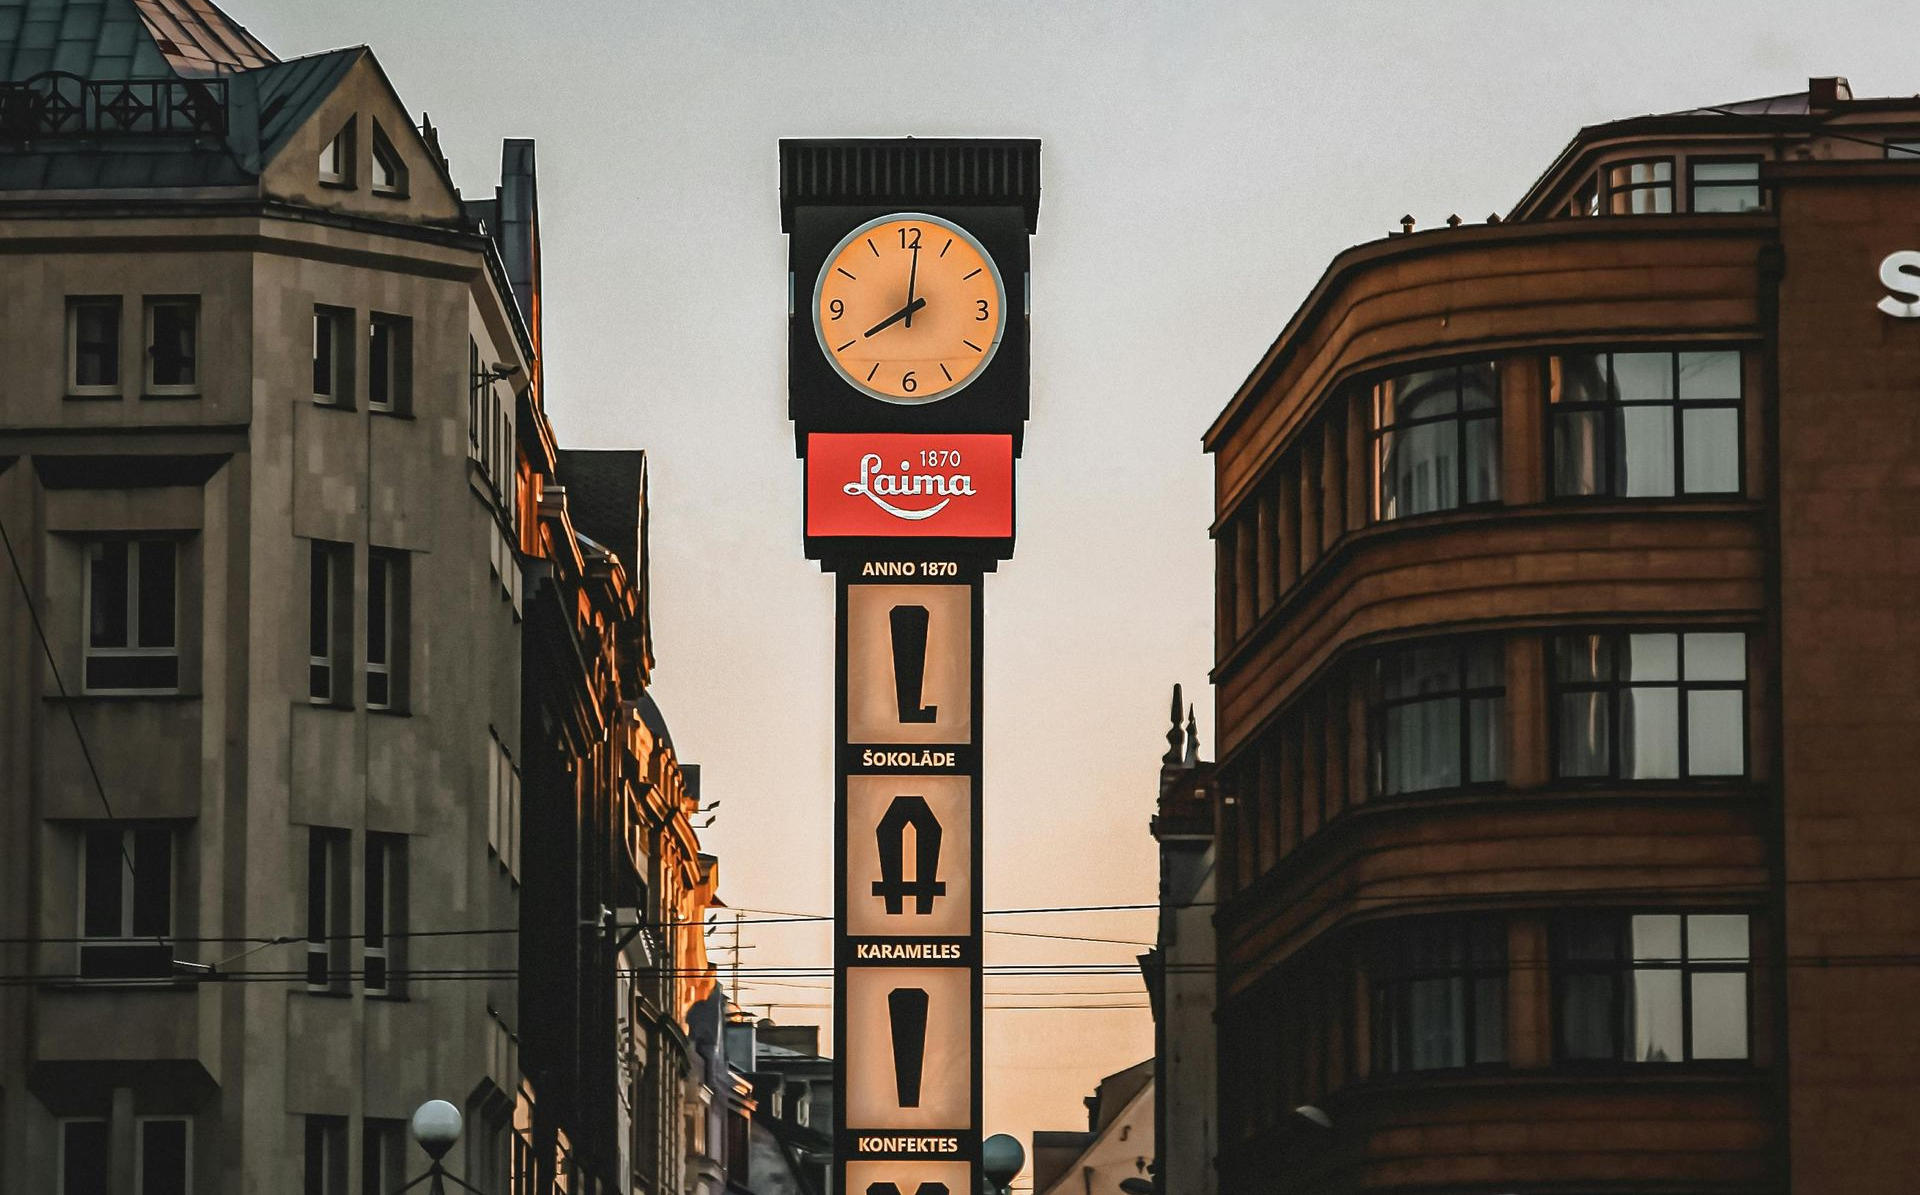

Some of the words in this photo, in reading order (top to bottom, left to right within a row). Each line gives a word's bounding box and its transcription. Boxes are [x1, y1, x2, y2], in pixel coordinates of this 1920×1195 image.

[897, 227, 922, 250] 12
[829, 299, 845, 321] 9
[975, 299, 990, 321] 3
[902, 371, 918, 392] 6
[919, 449, 961, 467] 1870
[842, 453, 977, 520] Laima
[862, 562, 916, 576] ANNO
[920, 562, 958, 576] 1870
[862, 749, 956, 768] ŠOKOLĀDE
[857, 944, 961, 959] KARAMELES
[858, 1137, 958, 1153] KONFEKTES
